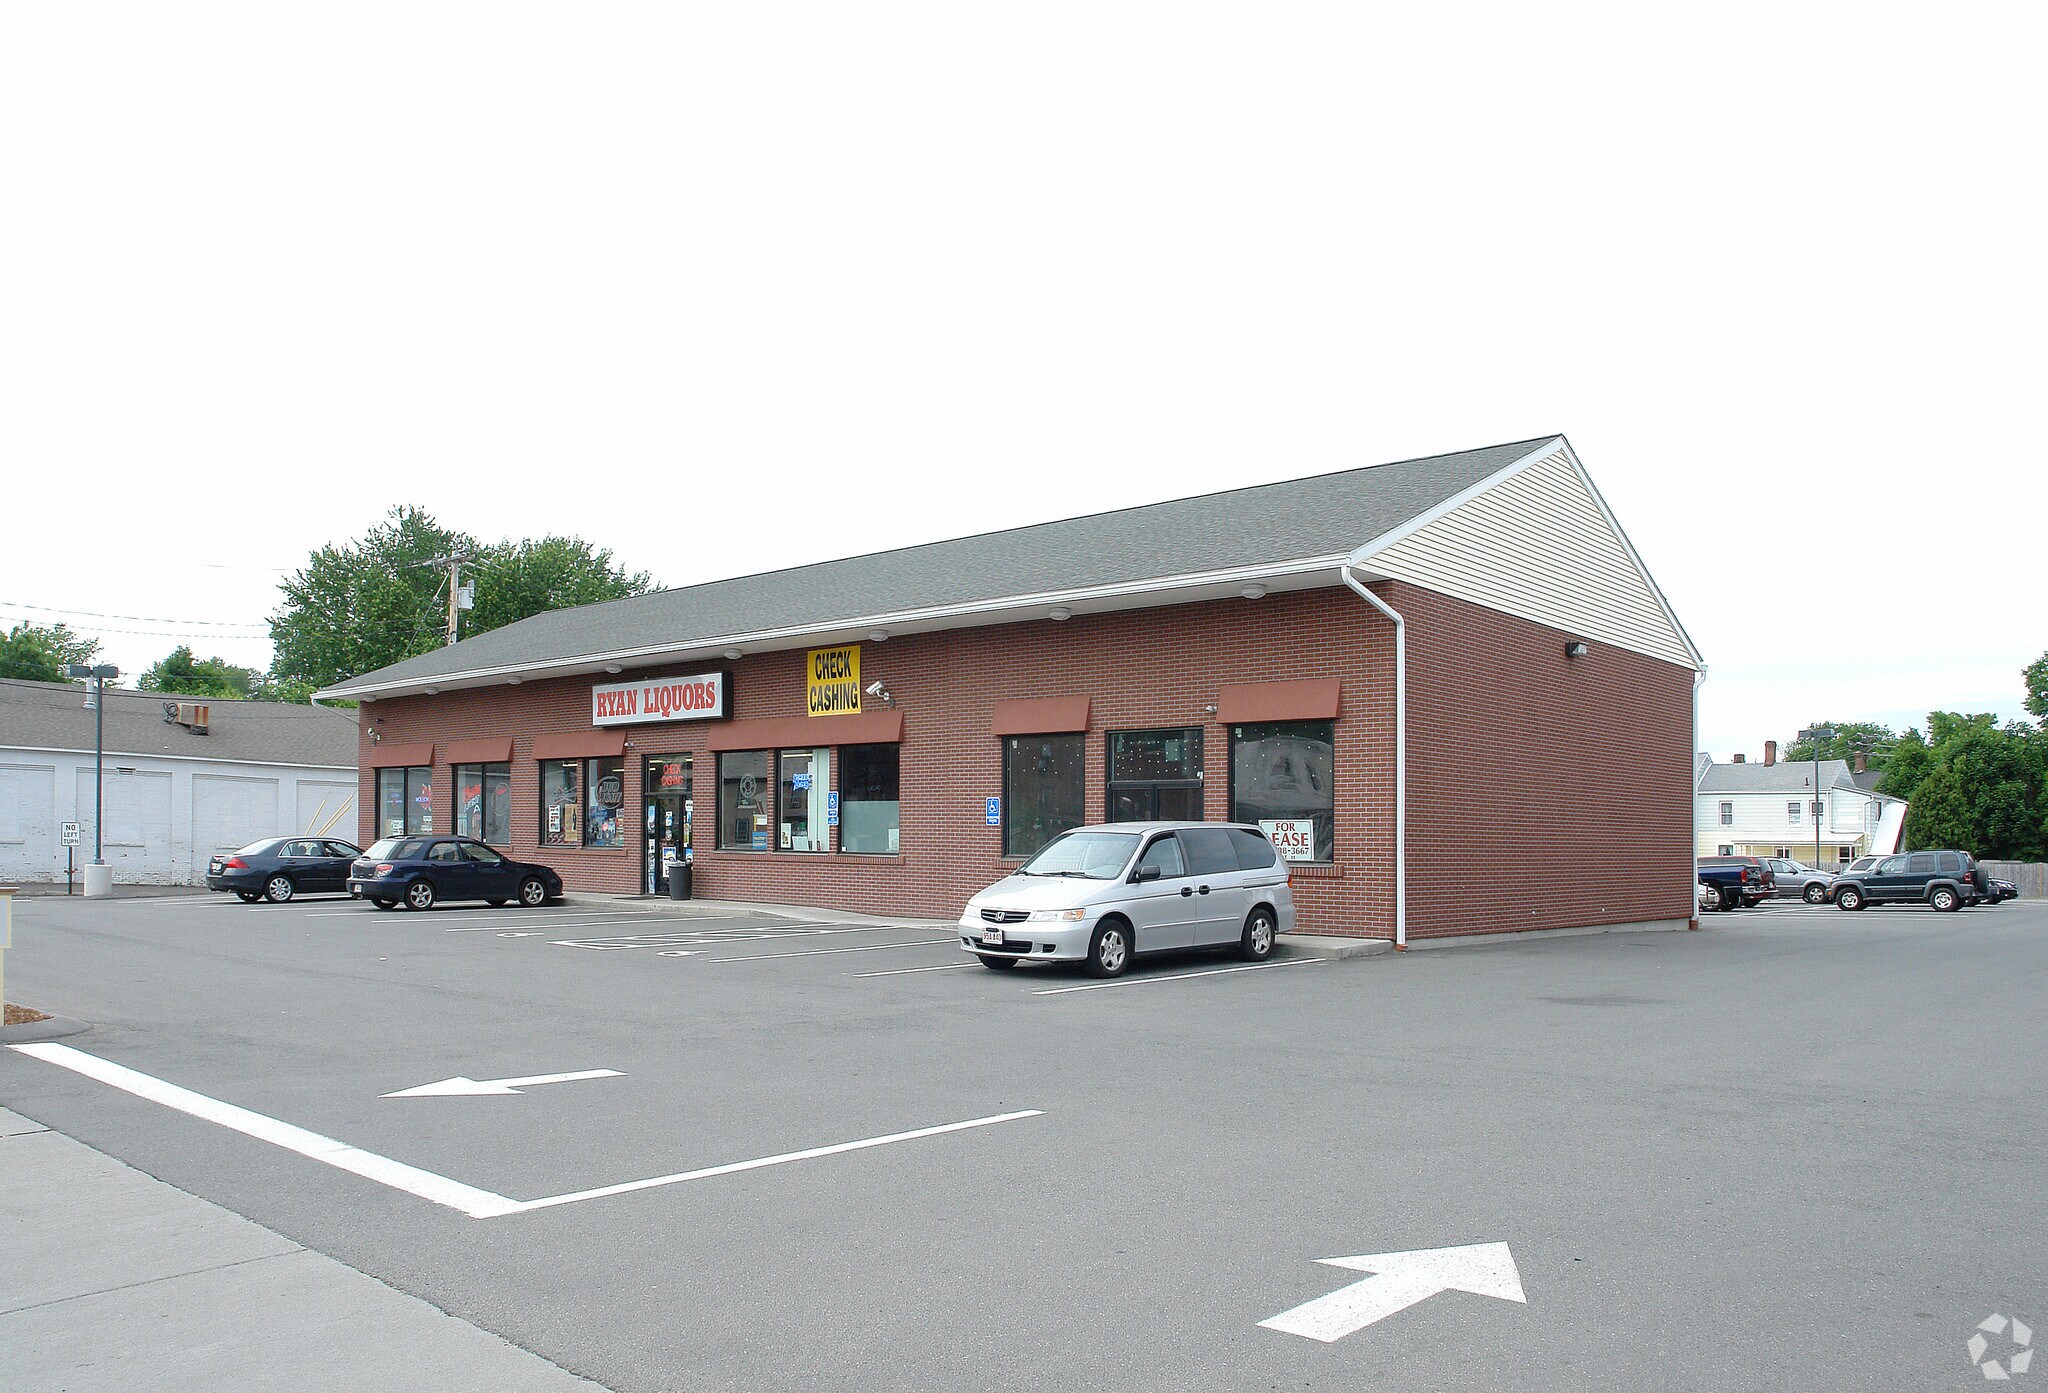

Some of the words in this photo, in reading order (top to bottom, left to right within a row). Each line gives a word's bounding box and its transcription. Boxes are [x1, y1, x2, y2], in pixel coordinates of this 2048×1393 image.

[815, 650, 852, 680] CHECK
[596, 689, 638, 717] RYAN
[643, 681, 716, 717] LIQUORS
[810, 682, 859, 712] CASHING
[1271, 833, 1309, 846] EASE
[1276, 823, 1295, 831] FOR
